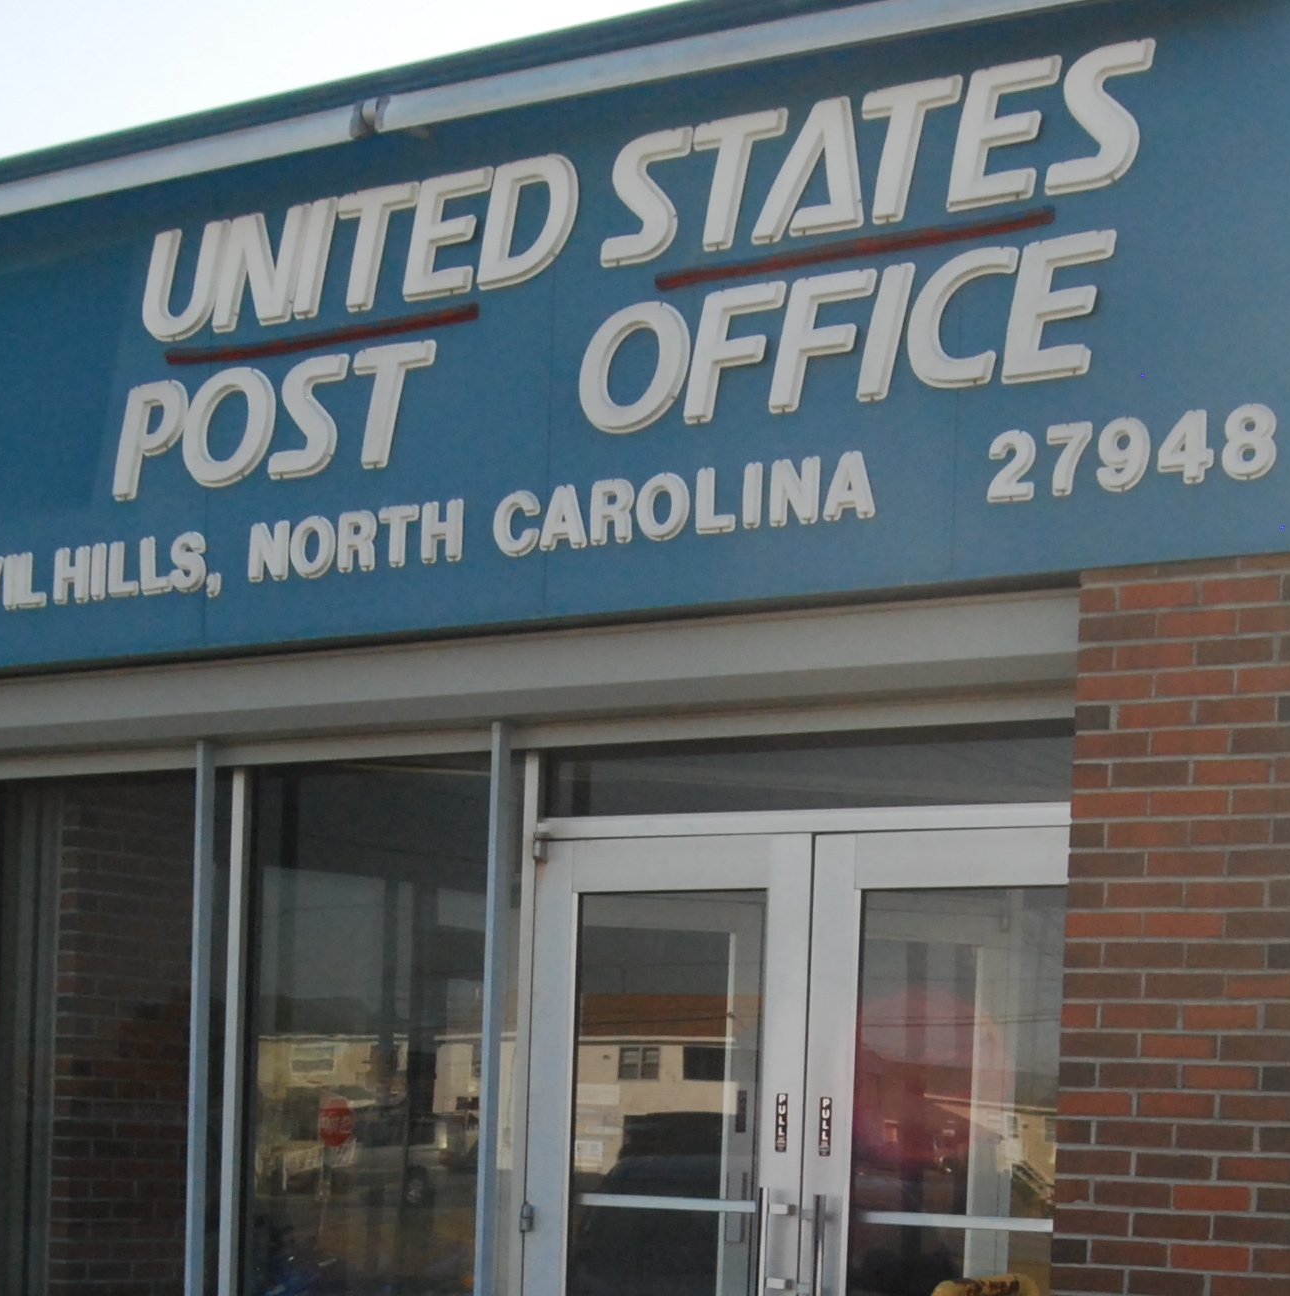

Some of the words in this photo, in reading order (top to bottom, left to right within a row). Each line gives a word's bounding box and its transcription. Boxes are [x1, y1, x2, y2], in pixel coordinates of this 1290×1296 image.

[141, 153, 579, 343] UNITED
[600, 37, 1155, 268] STATES
[111, 339, 437, 502] POST
[579, 227, 1117, 434] OFFICE
[53, 531, 221, 604] HILLS,
[248, 498, 464, 584] NORTH
[492, 450, 877, 558] CAROLINA
[987, 402, 1278, 503] 27948
[778, 1094, 786, 1135] PULL
[822, 1098, 830, 1140] PULL
